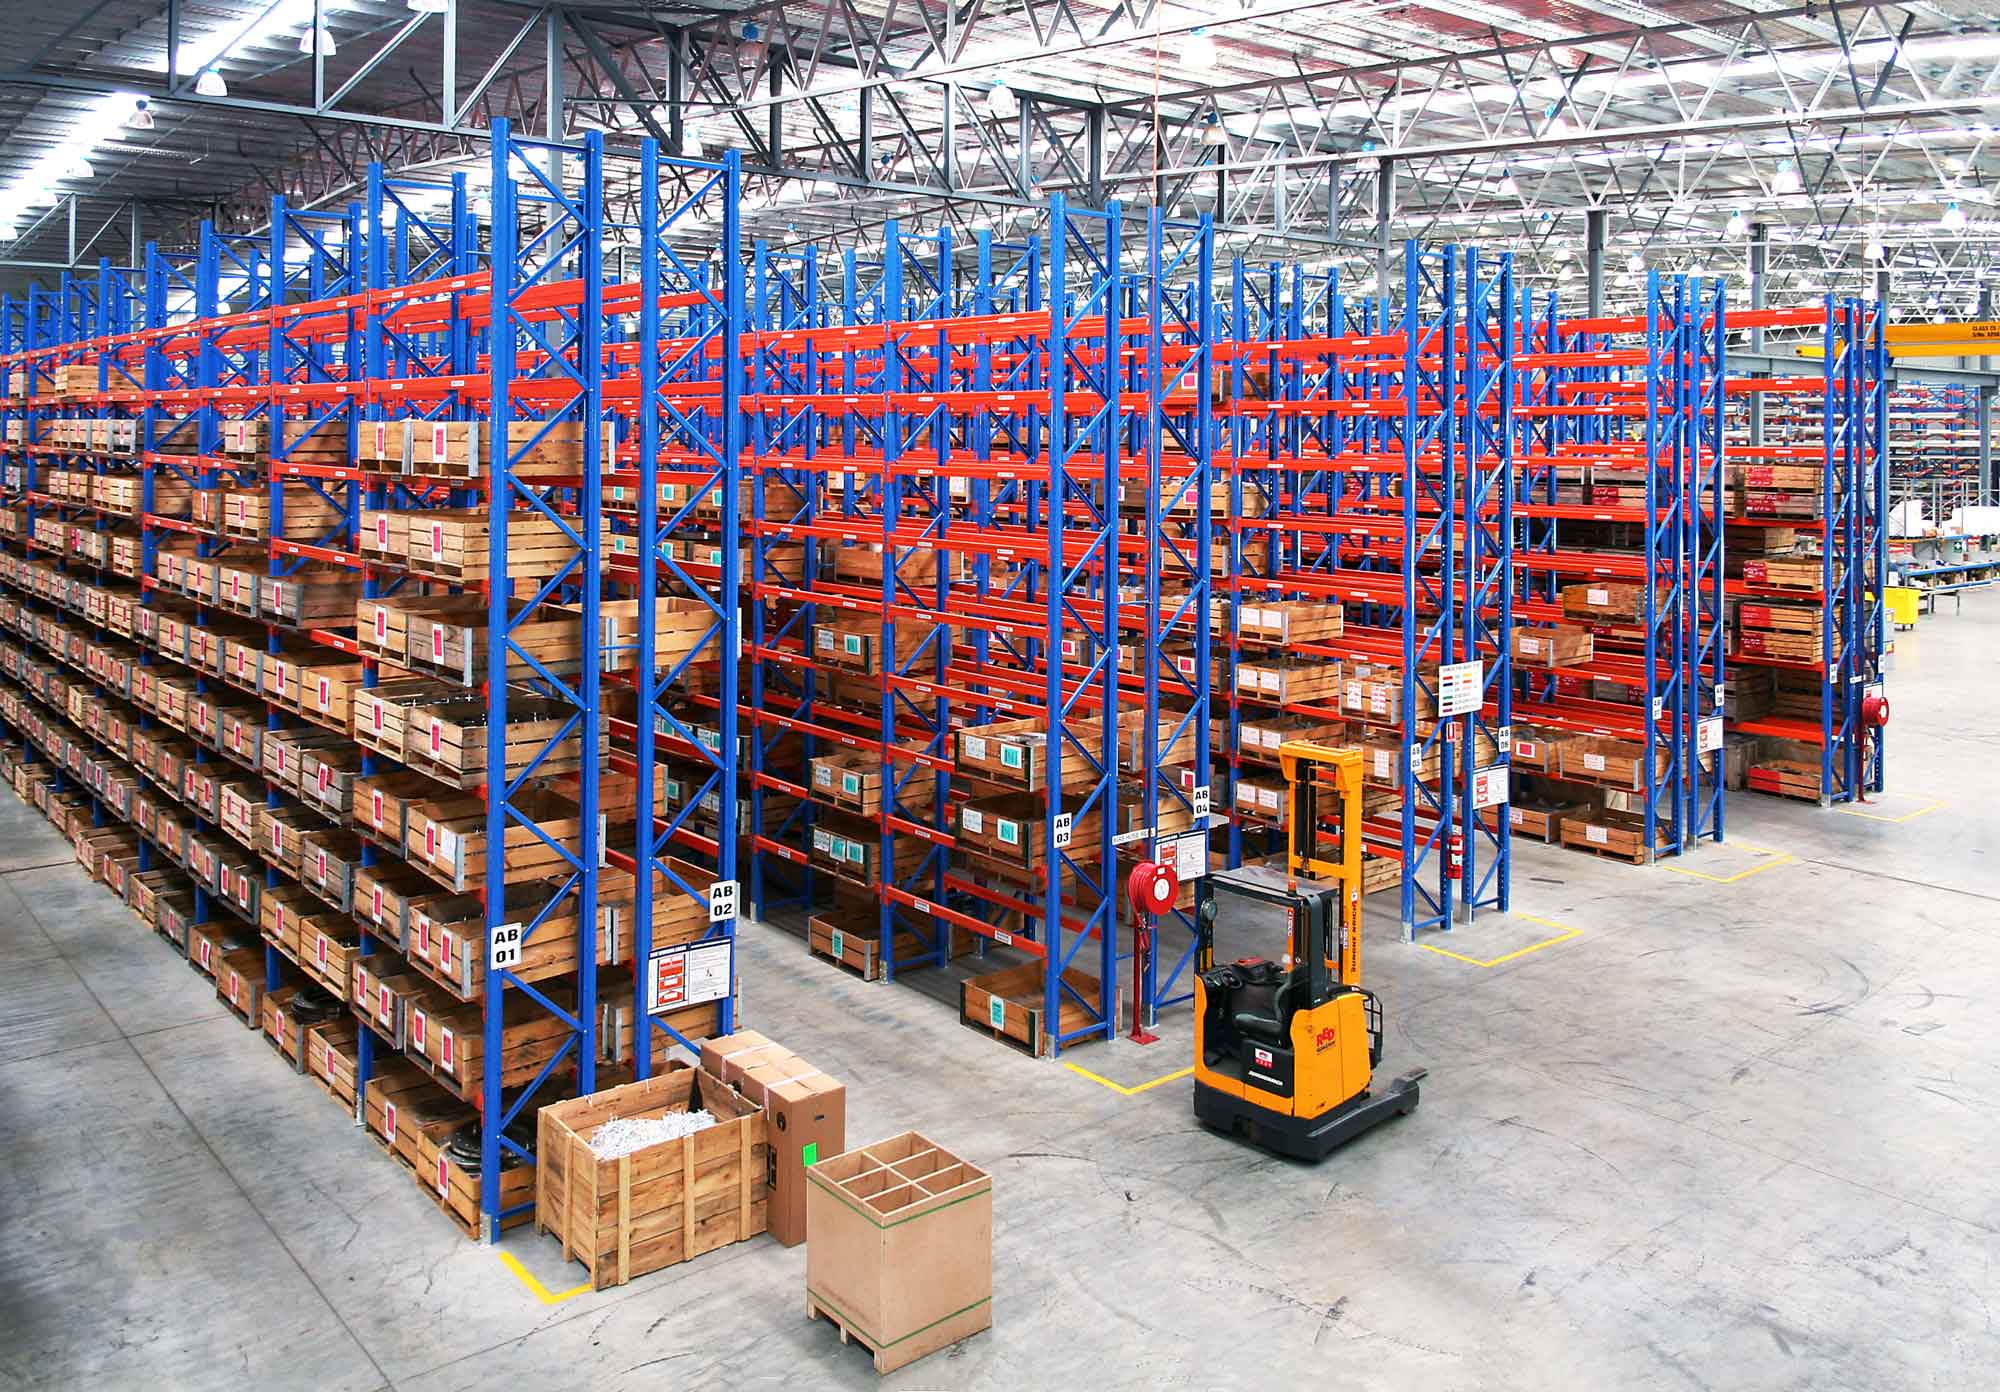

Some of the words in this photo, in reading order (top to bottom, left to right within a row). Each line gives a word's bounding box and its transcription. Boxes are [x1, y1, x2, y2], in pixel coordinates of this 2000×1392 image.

[1500, 729, 1509, 737] AB
[1412, 759, 1420, 768] 05
[1195, 789, 1208, 800] AB
[1196, 804, 1208, 814] 04
[1056, 817, 1070, 829] AB
[1056, 832, 1069, 843] 03
[712, 884, 733, 899] AB
[713, 903, 732, 916] 02
[494, 928, 519, 945] AB
[495, 949, 516, 963] 01
